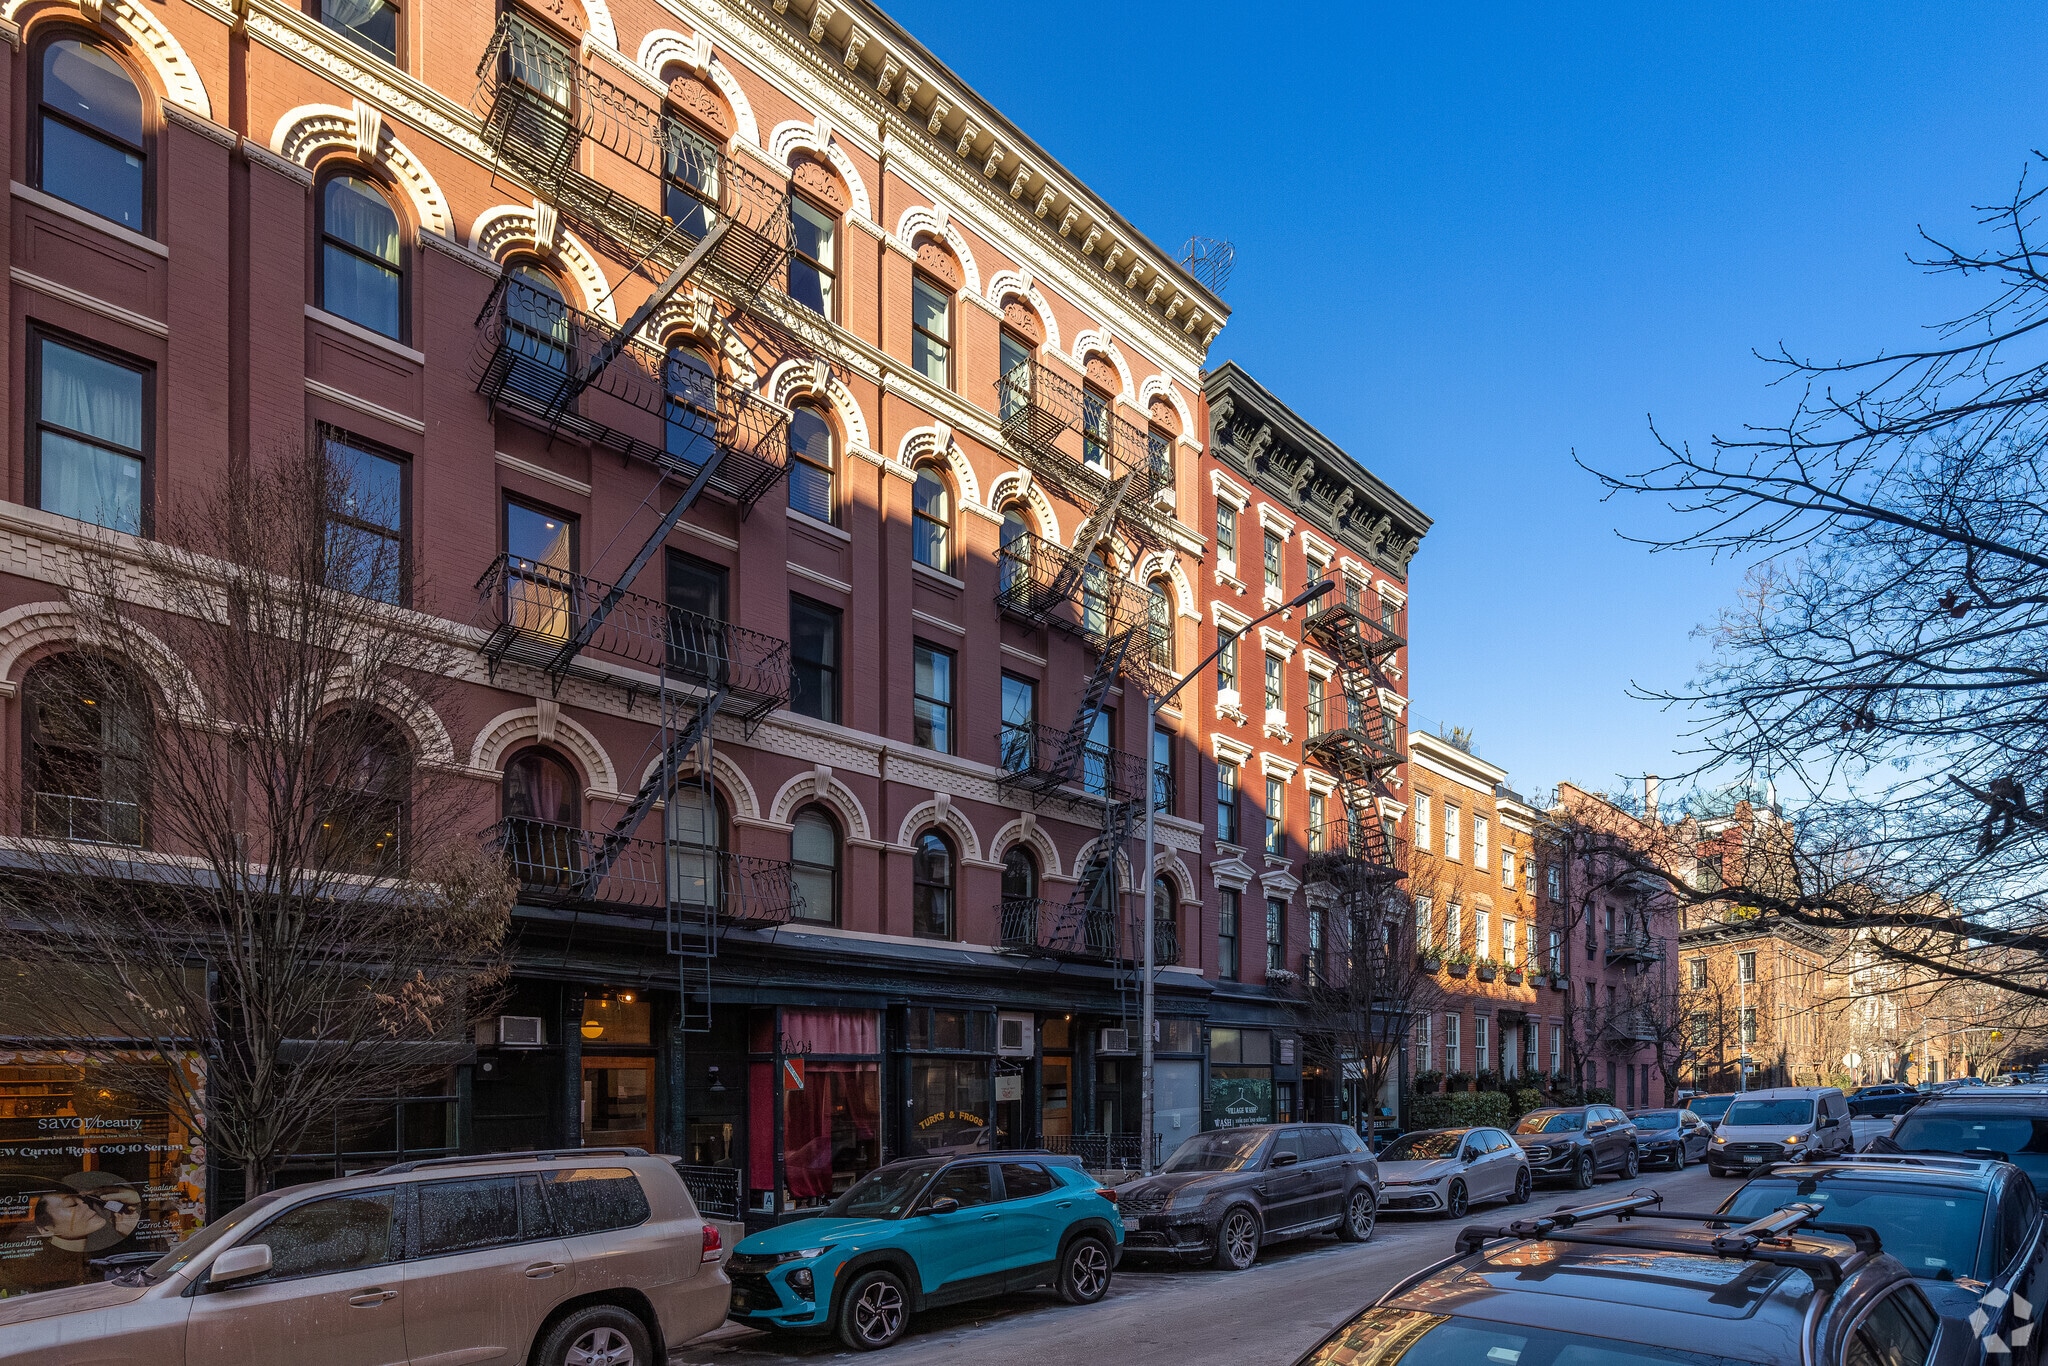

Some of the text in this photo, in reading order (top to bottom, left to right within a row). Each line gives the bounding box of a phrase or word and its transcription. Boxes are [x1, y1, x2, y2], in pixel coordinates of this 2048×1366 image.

[918, 1112, 945, 1129] TURKS
[960, 1111, 984, 1127] FROGS
[0, 1148, 17, 1157] EW
[20, 1147, 63, 1159] Carrot
[66, 1145, 97, 1157] Rose
[144, 1143, 183, 1152] Serum
[143, 1184, 179, 1193] Squalane
[0, 1195, 29, 1205] oQ-10
[766, 1194, 773, 1205] A
[137, 1221, 161, 1229] Carrot
[0, 1239, 43, 1249] staxanthin
